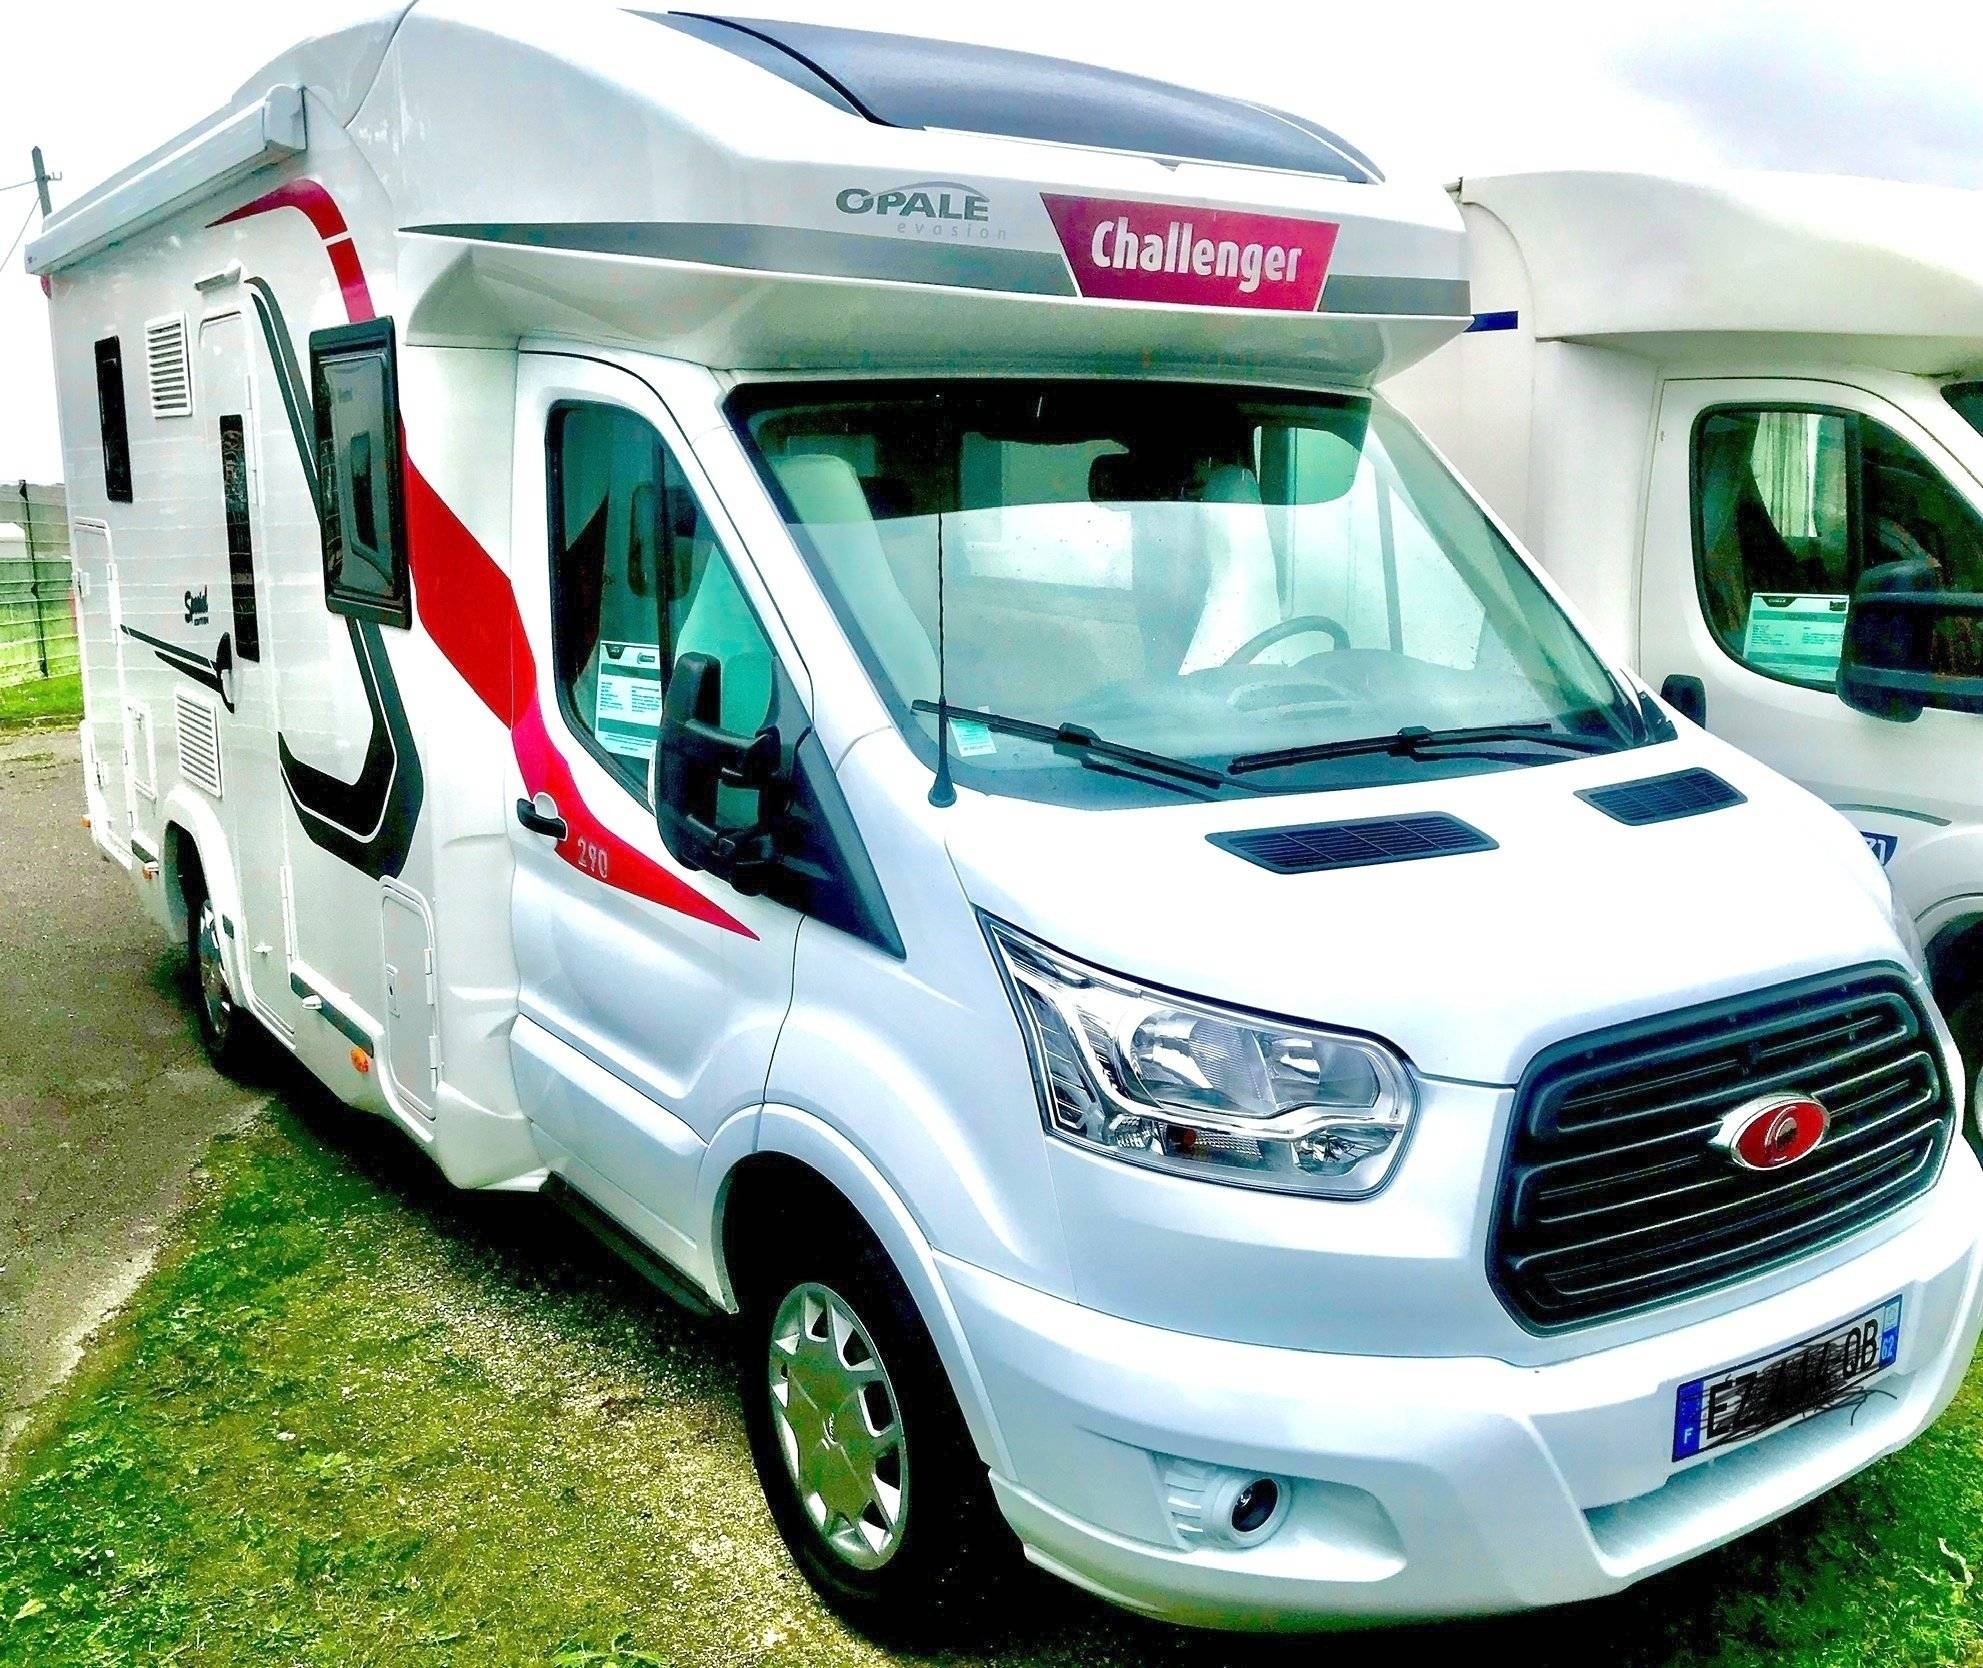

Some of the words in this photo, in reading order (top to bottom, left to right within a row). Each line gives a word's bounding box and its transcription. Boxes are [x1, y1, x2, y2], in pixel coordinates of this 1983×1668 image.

[836, 188, 989, 222] OPALE
[896, 221, 1007, 241] evasion
[1091, 216, 1303, 294] Challenger
[577, 836, 608, 878] 290
[1683, 1427, 1694, 1444] F
